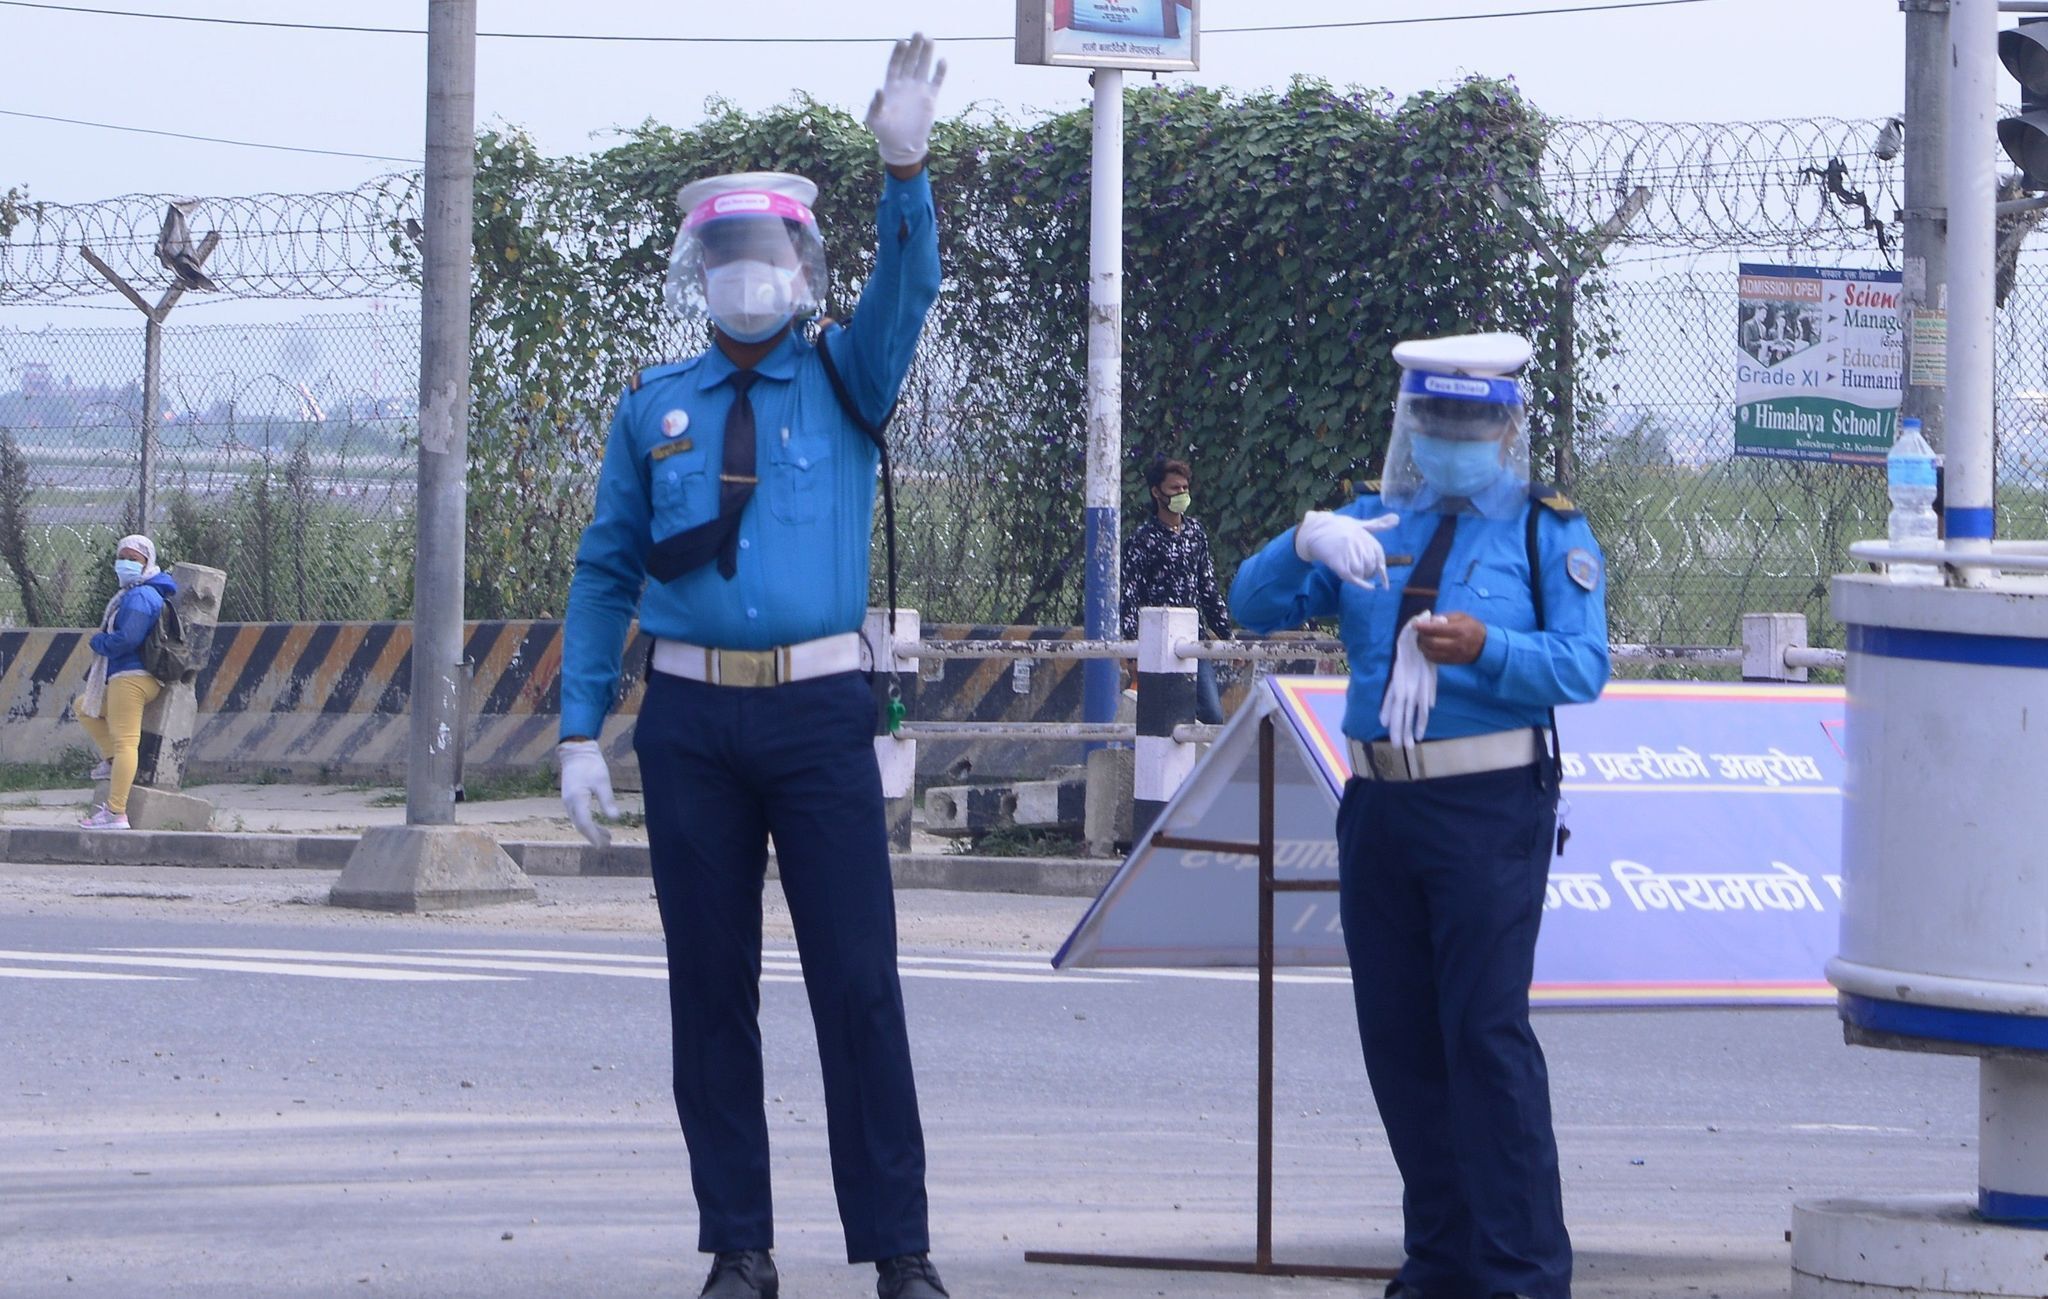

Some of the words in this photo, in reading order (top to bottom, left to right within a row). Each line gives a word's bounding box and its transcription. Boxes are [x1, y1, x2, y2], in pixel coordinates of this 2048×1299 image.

[1740, 279, 1793, 296] ADMISSION
[1794, 282, 1821, 298] OPEN
[1738, 365, 1796, 386] Grade
[1801, 370, 1819, 387] XI
[1754, 403, 1825, 439] Himalaya
[1832, 408, 1881, 437] School
[1588, 745, 1711, 781] प्रहरीको
[1709, 747, 1823, 786] अनुरोध
[1609, 859, 1825, 912] नियमको
